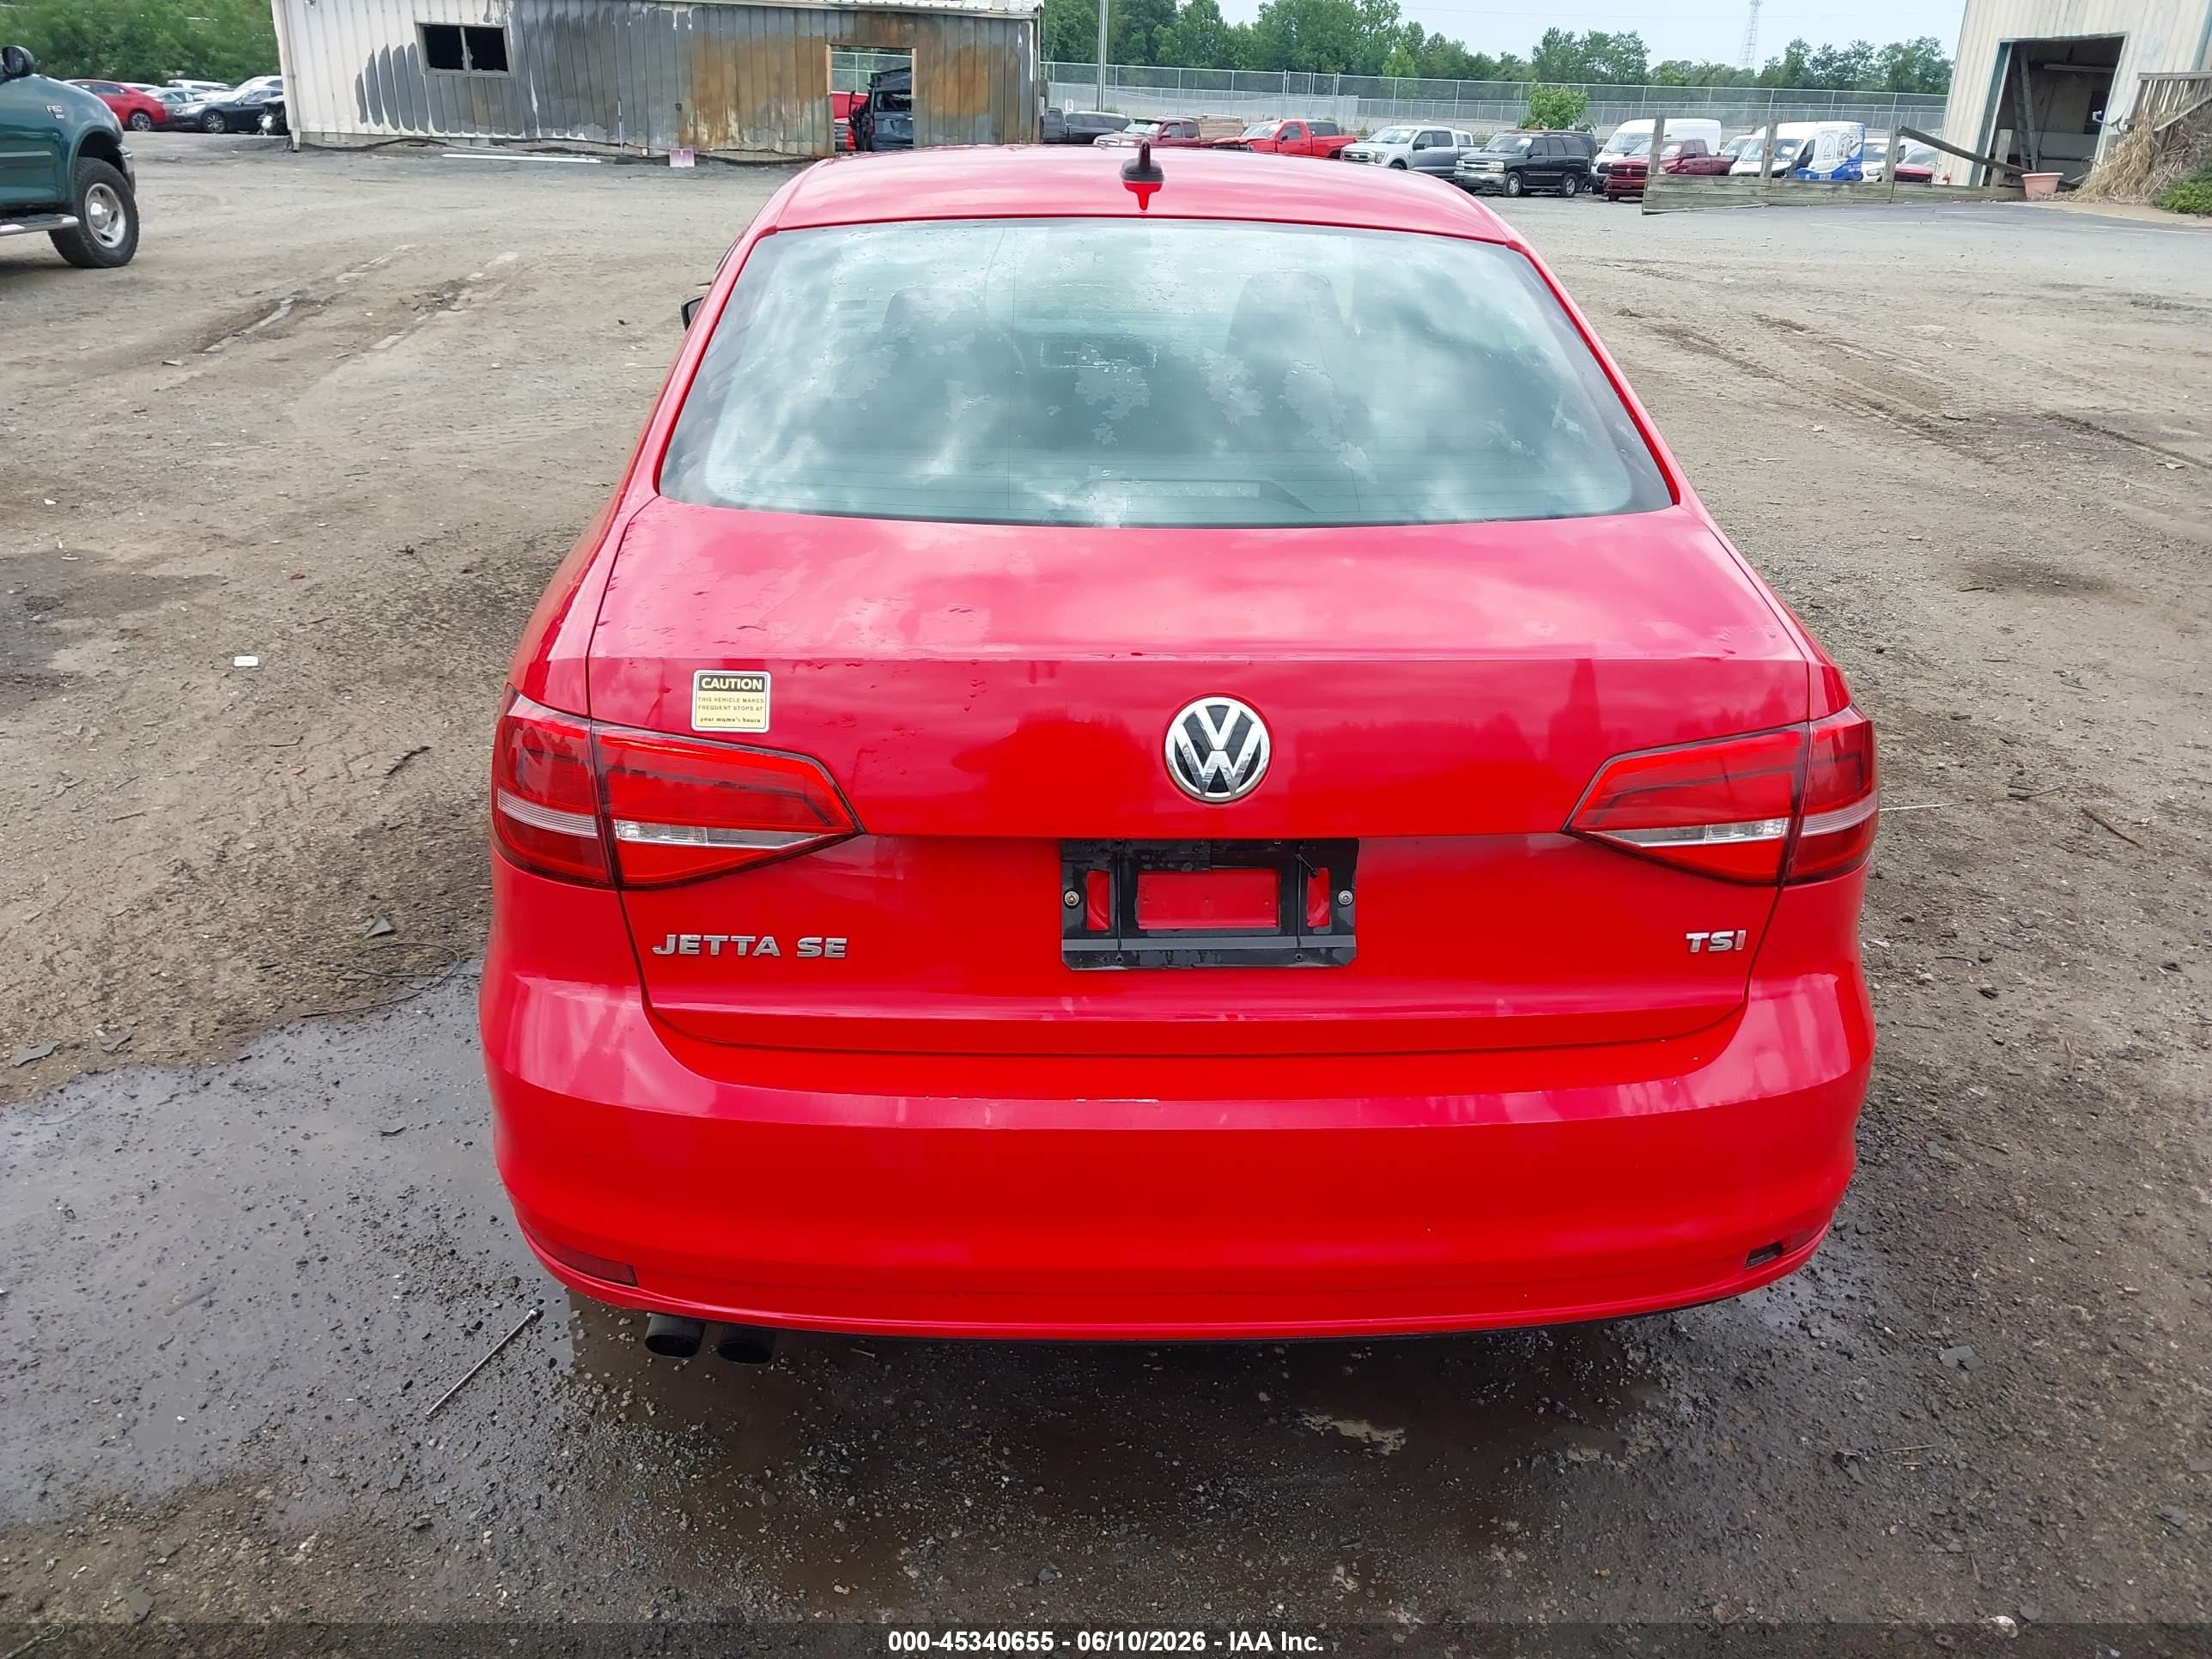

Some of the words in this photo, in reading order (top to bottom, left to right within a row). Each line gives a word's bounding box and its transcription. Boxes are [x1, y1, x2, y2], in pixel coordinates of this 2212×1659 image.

[701, 678, 763, 690] CAUTION
[652, 934, 781, 957] JETTA
[796, 937, 848, 958] SE
[1686, 929, 1747, 953] TSI
